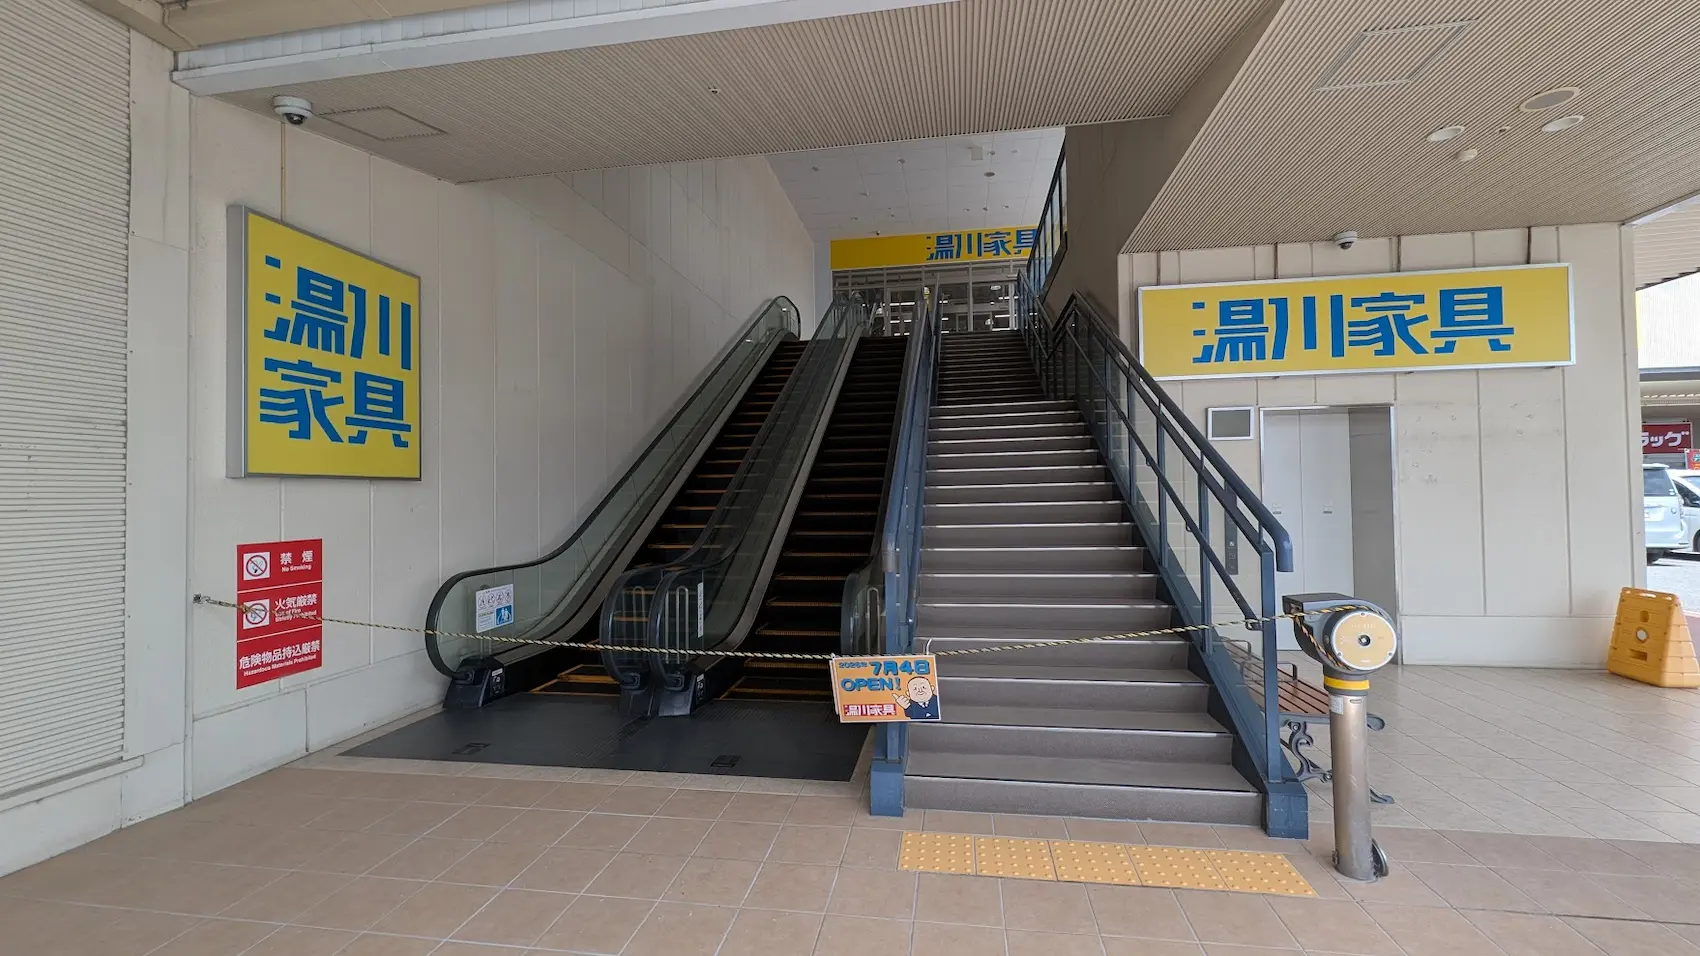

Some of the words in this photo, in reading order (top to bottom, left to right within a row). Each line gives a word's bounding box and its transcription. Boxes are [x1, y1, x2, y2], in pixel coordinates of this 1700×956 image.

[264, 255, 411, 371] 湯川
[1192, 286, 1514, 364] 湯川家具
[260, 357, 411, 448] 家具
[275, 593, 317, 611] 火気厳禁
[239, 640, 320, 669] 危険物品持込厳禁
[271, 659, 294, 670] Materials
[293, 654, 317, 664] Prohibited
[869, 660, 930, 675] 7月4日
[841, 677, 901, 691] OPEN!
[845, 704, 895, 716] 湯川家具
